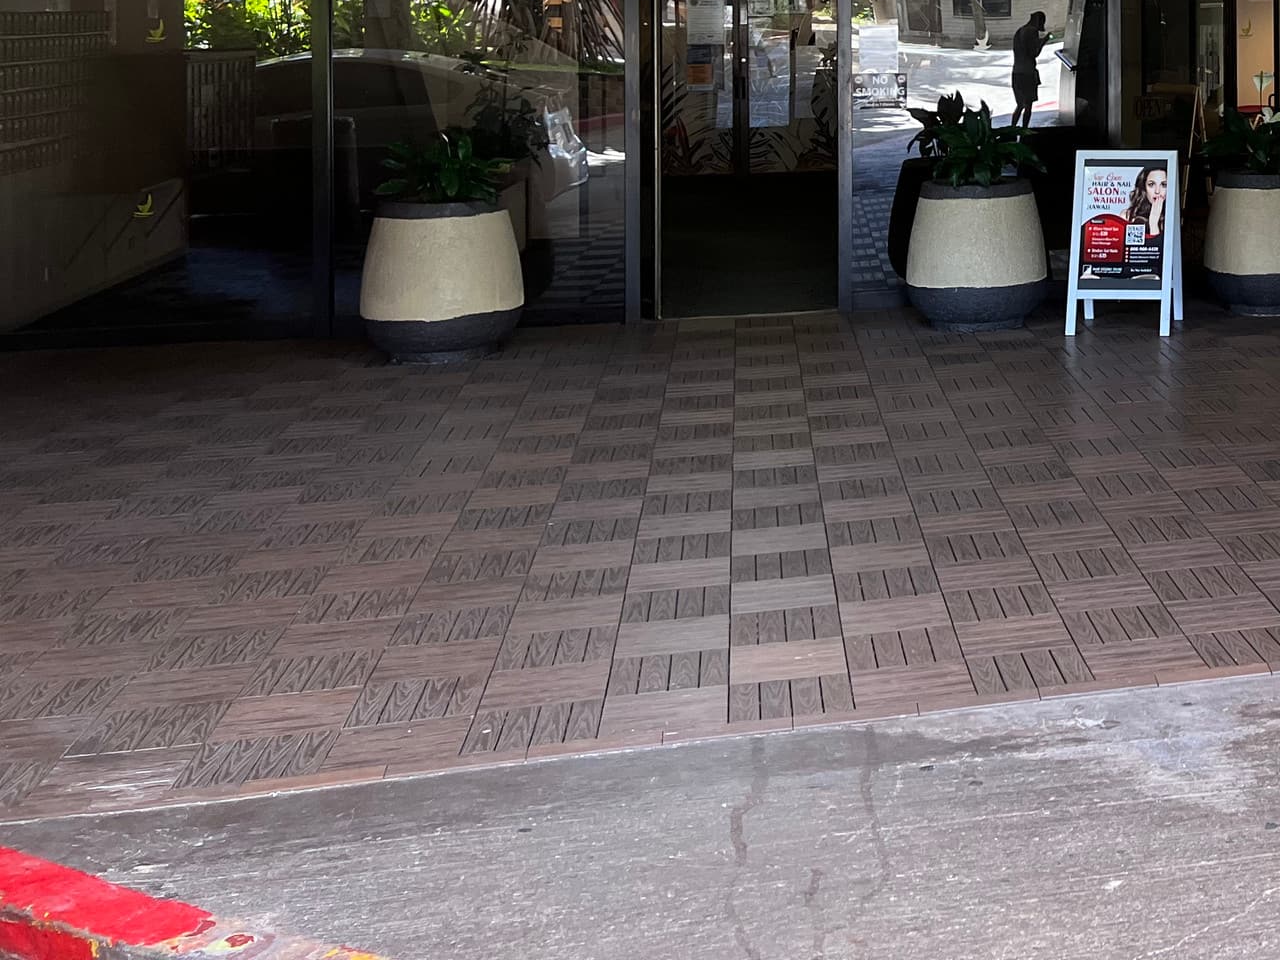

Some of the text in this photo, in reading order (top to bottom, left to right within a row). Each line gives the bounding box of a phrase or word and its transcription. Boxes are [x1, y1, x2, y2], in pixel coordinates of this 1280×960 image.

[872, 75, 888, 85] NO
[855, 87, 905, 97] SMOKING
[1088, 187, 1119, 195] SALON
[1093, 196, 1126, 204] WAIKIKI
